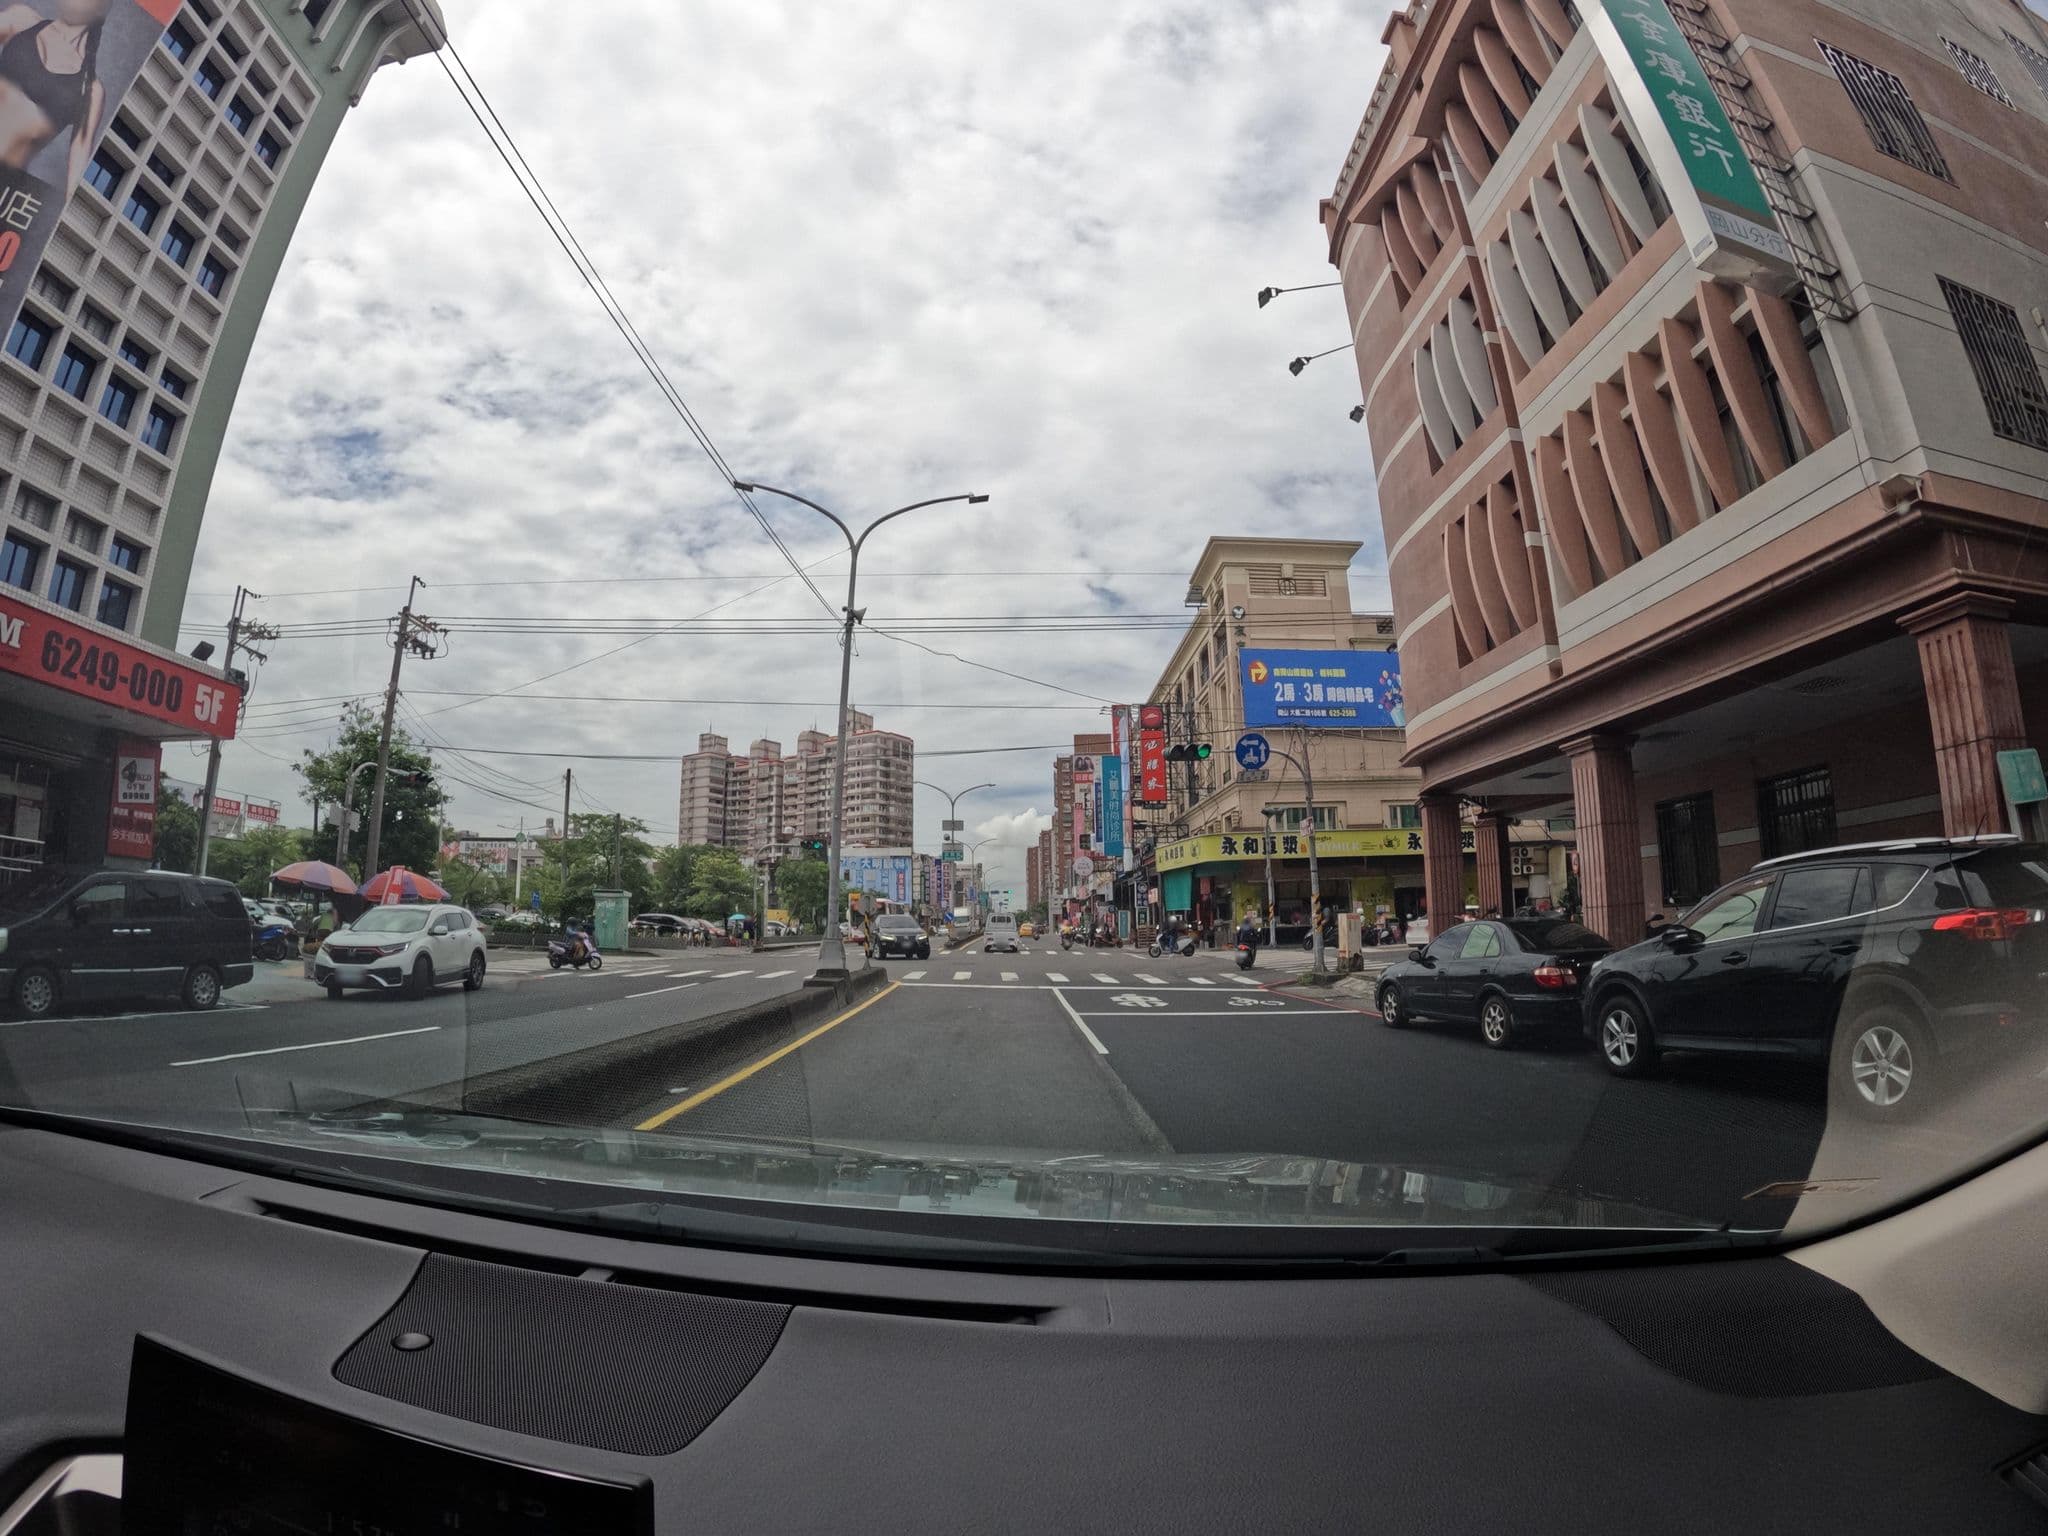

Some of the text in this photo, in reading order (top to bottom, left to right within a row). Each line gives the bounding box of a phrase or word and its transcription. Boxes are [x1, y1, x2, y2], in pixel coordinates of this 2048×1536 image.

[1621, 0, 1734, 177] 金庫銀行
[0, 187, 42, 230] 店
[41, 631, 184, 712] 6249-000
[194, 684, 225, 724] 5F
